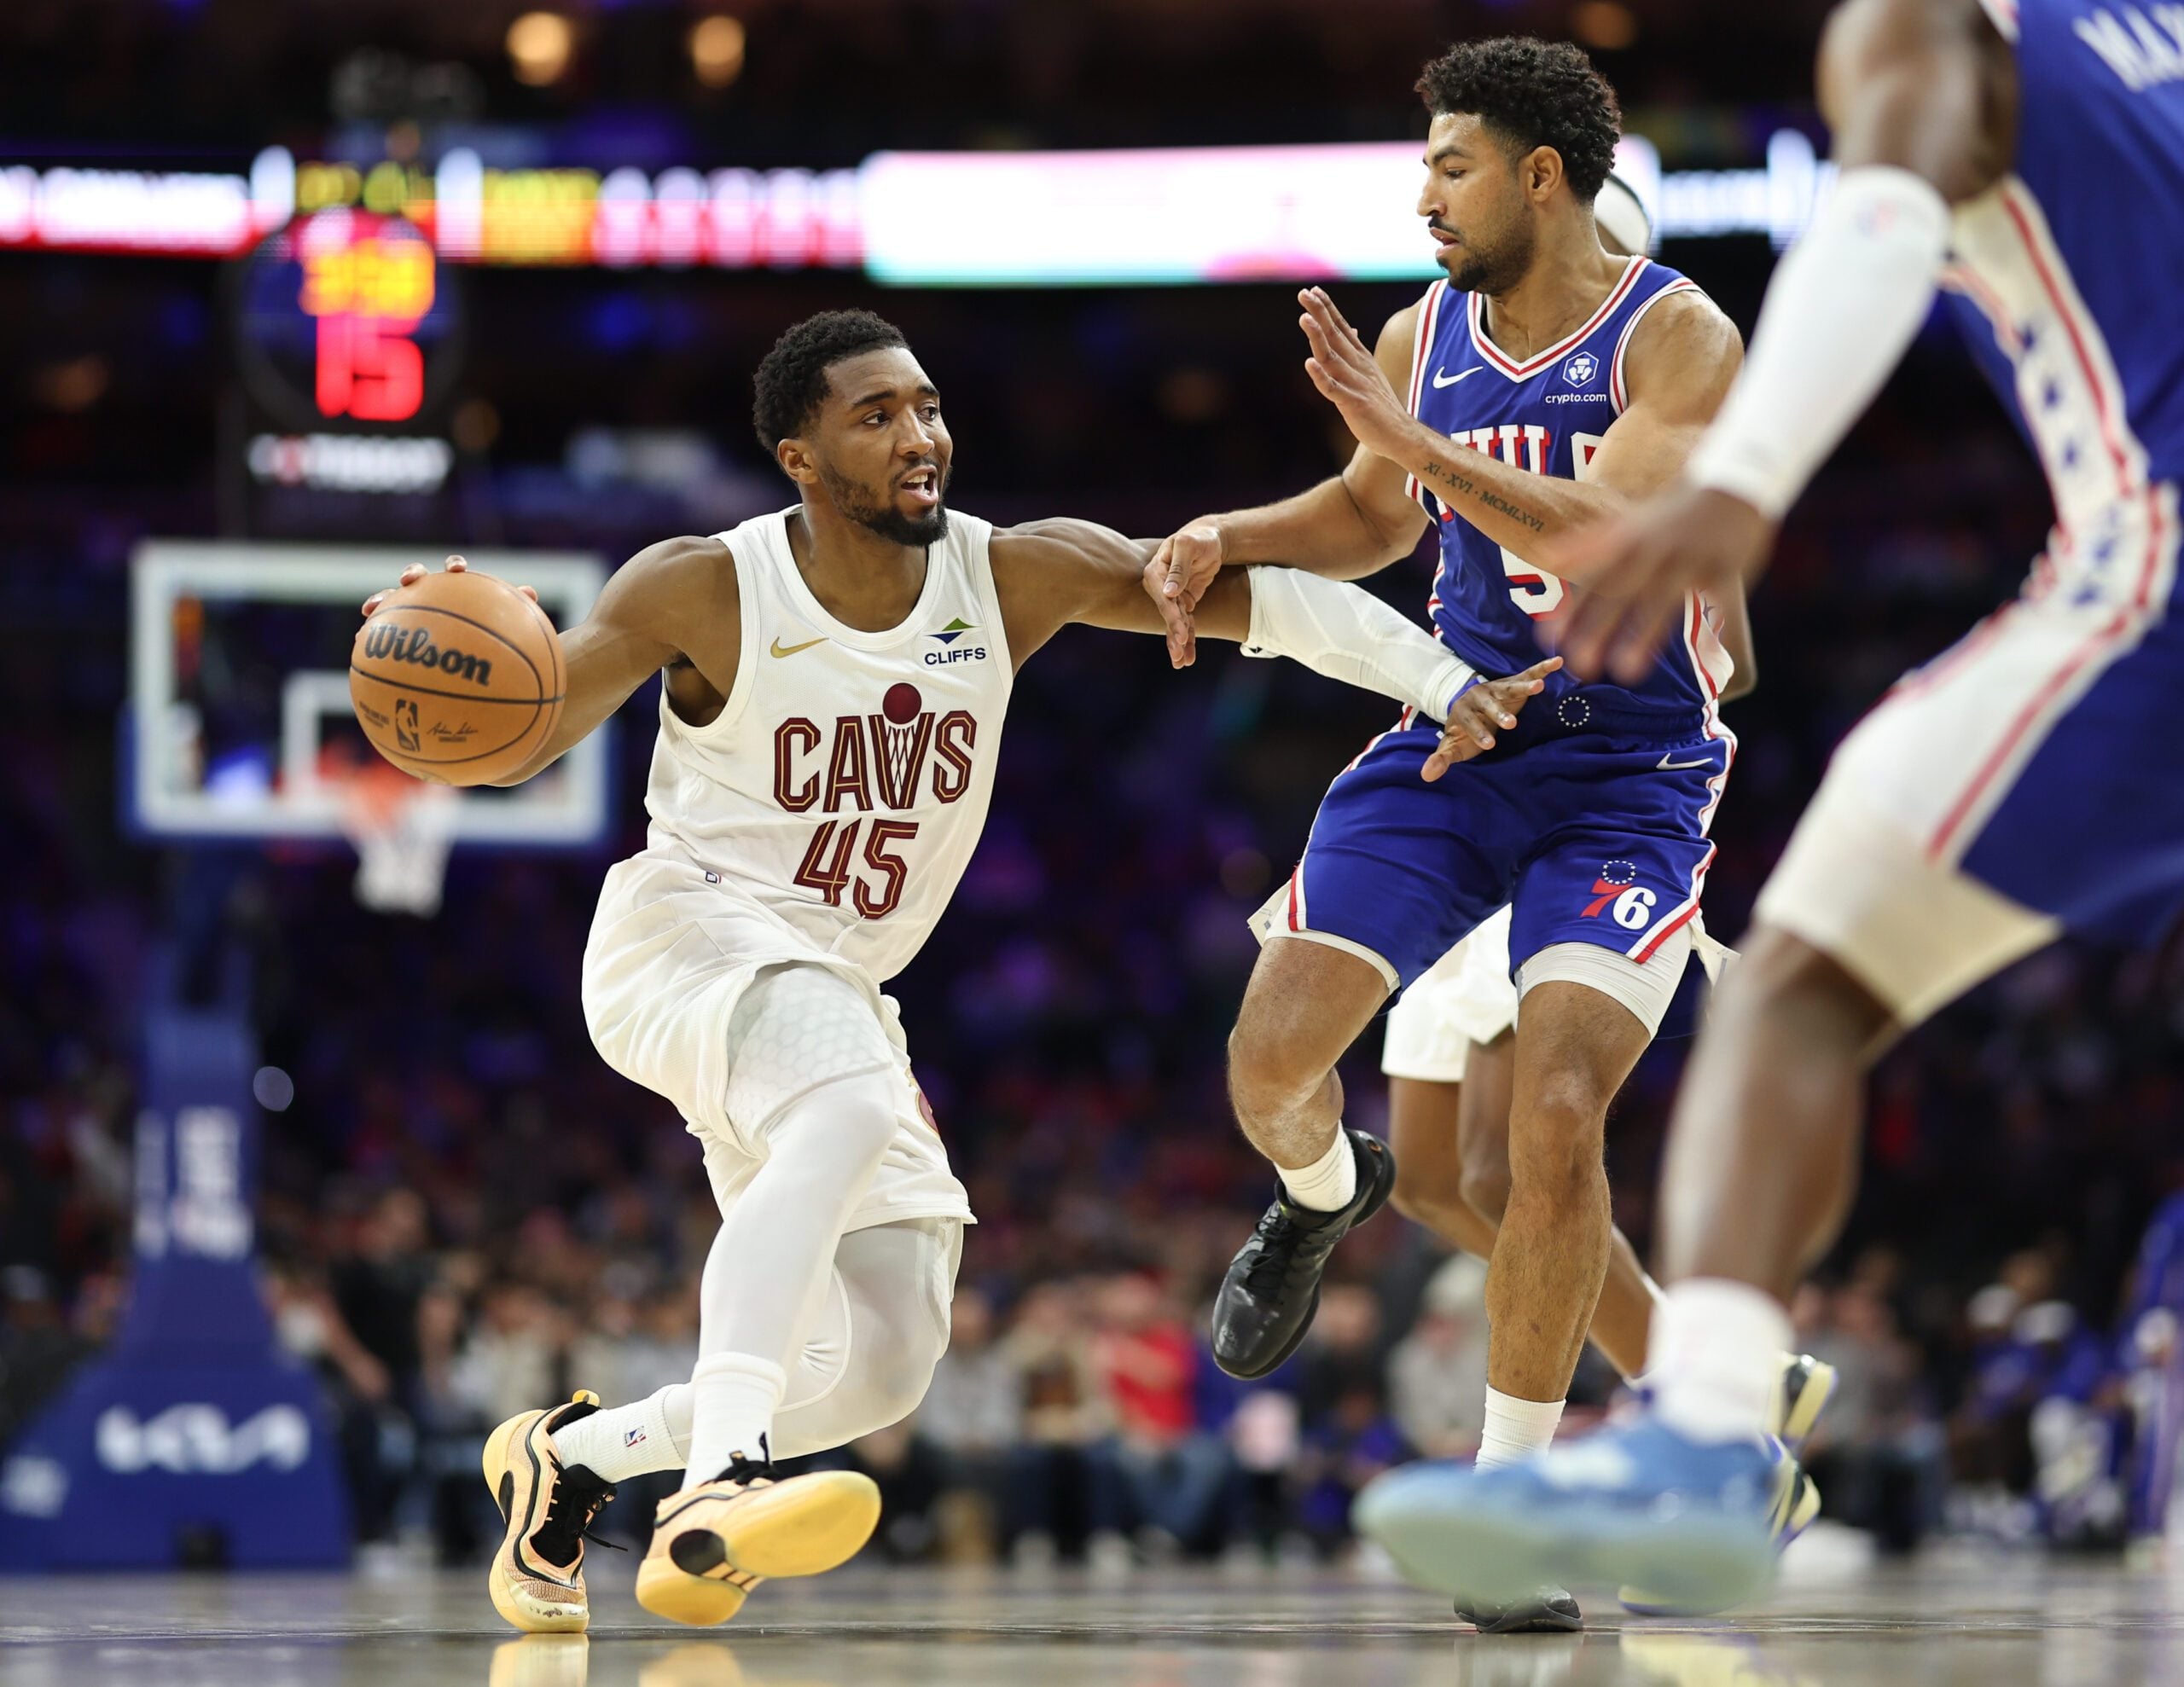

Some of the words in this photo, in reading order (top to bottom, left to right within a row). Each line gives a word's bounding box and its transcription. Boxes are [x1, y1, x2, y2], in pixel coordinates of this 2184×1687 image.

[1545, 392, 1606, 404] crypto.com
[1423, 461, 1441, 476] XI
[1446, 472, 1473, 494] XVI
[1479, 491, 1544, 532] MCMLXVI
[364, 624, 491, 687] Wilson
[925, 647, 986, 665] CLIFFS
[774, 710, 977, 813] CAVS
[793, 817, 919, 919] 45
[1580, 878, 1657, 930] 76
